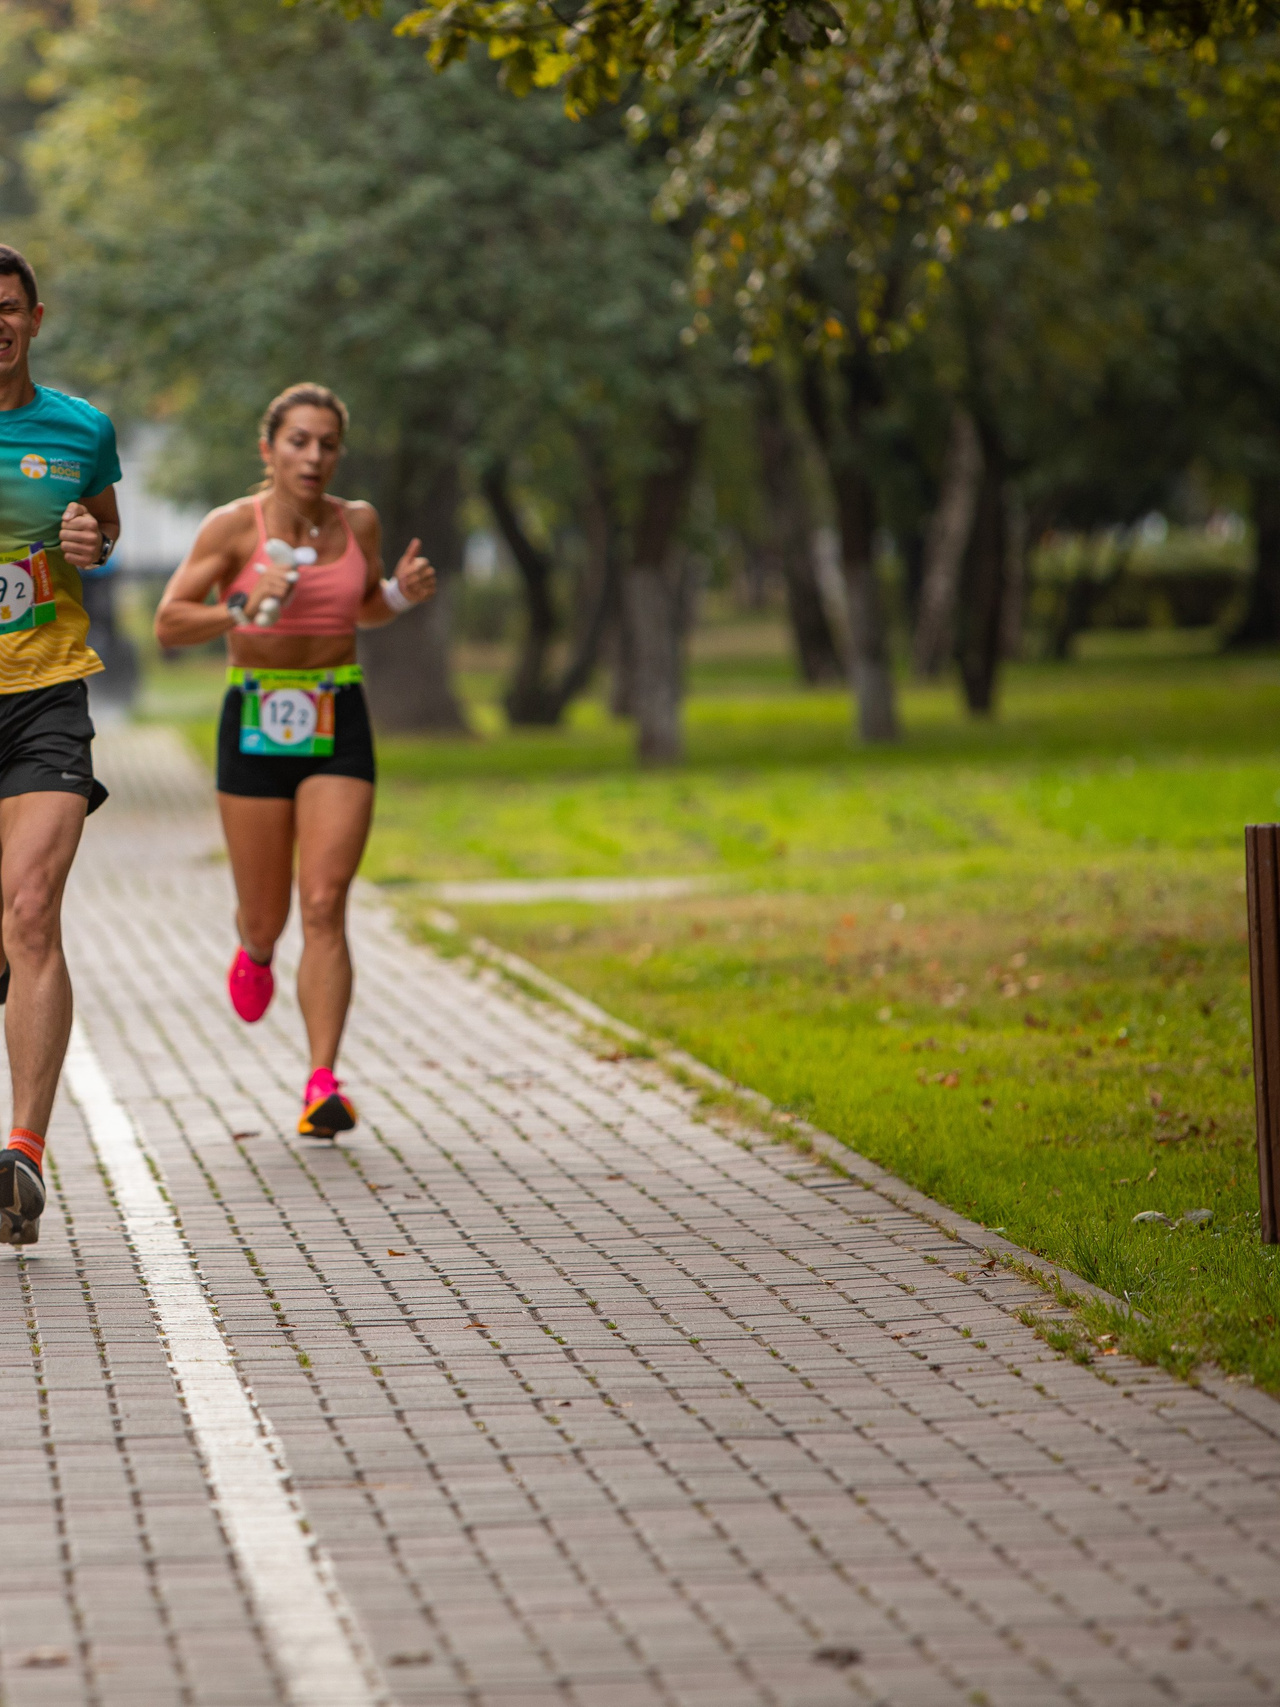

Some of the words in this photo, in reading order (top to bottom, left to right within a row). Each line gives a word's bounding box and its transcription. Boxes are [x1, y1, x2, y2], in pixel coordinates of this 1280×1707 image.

[50, 465, 81, 478] SOCHI
[14, 581, 27, 600] 2
[269, 700, 294, 726] 12
